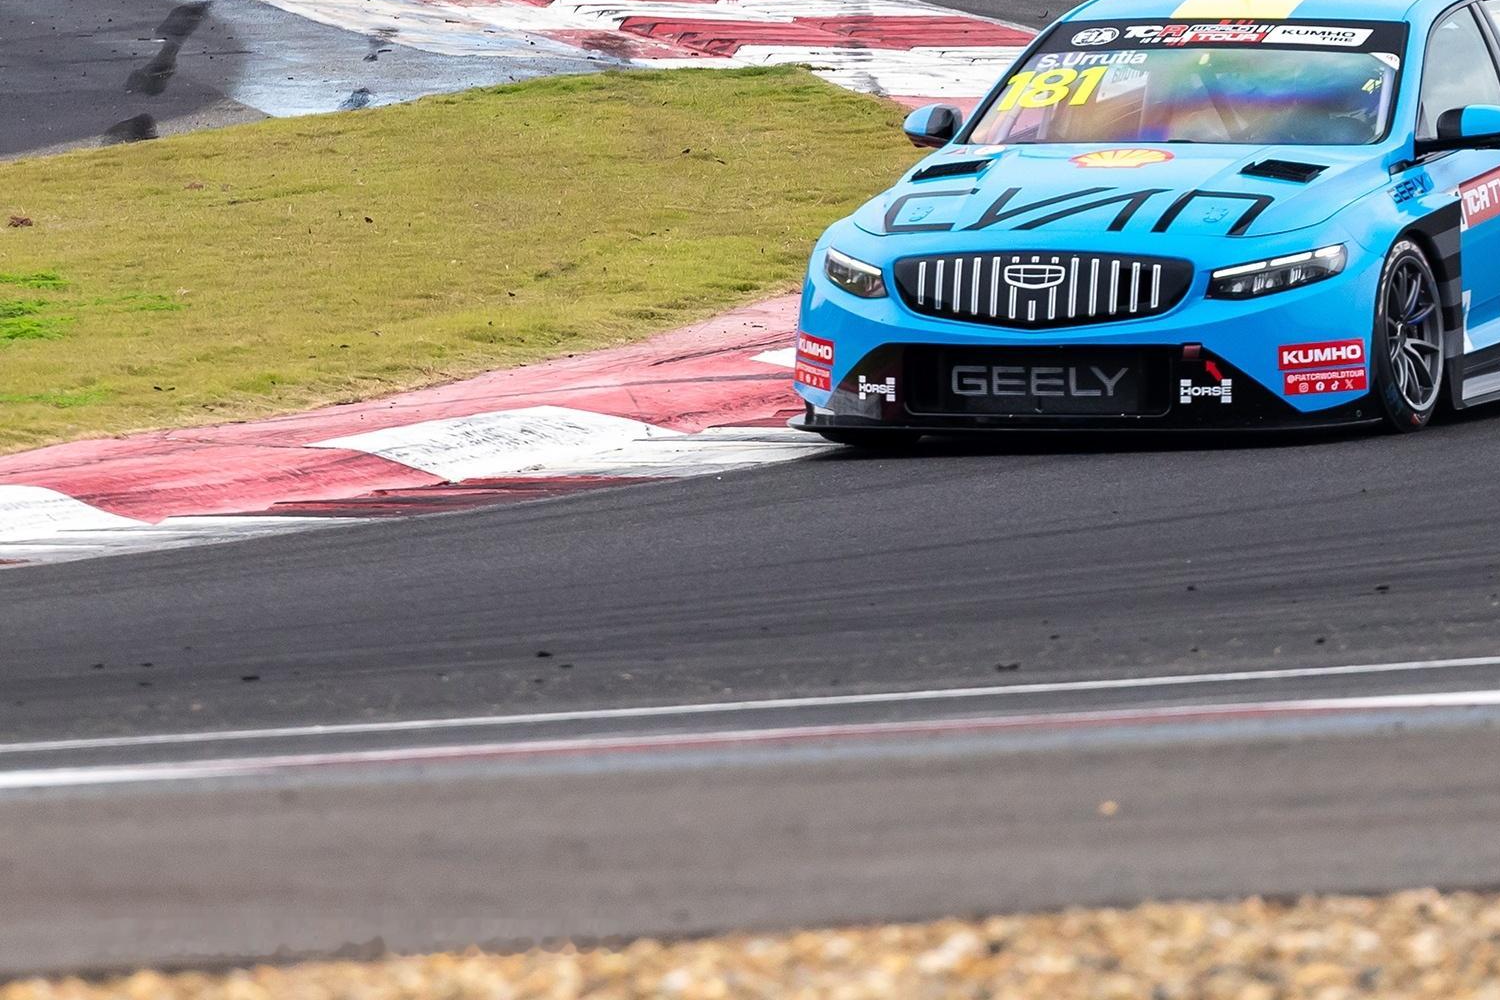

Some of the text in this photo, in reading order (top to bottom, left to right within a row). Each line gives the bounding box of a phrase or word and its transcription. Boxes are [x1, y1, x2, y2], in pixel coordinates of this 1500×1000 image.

[1072, 28, 1119, 45] FIA
[1124, 25, 1189, 38] TCR
[1281, 28, 1357, 38] KUMHO
[1196, 32, 1261, 42] TOUR
[1319, 35, 1354, 43] TIRE
[1037, 49, 1148, 69] S.Urrutia
[997, 66, 1110, 112] 181
[1283, 344, 1362, 365] KUMHO
[950, 365, 1129, 397] GEELY
